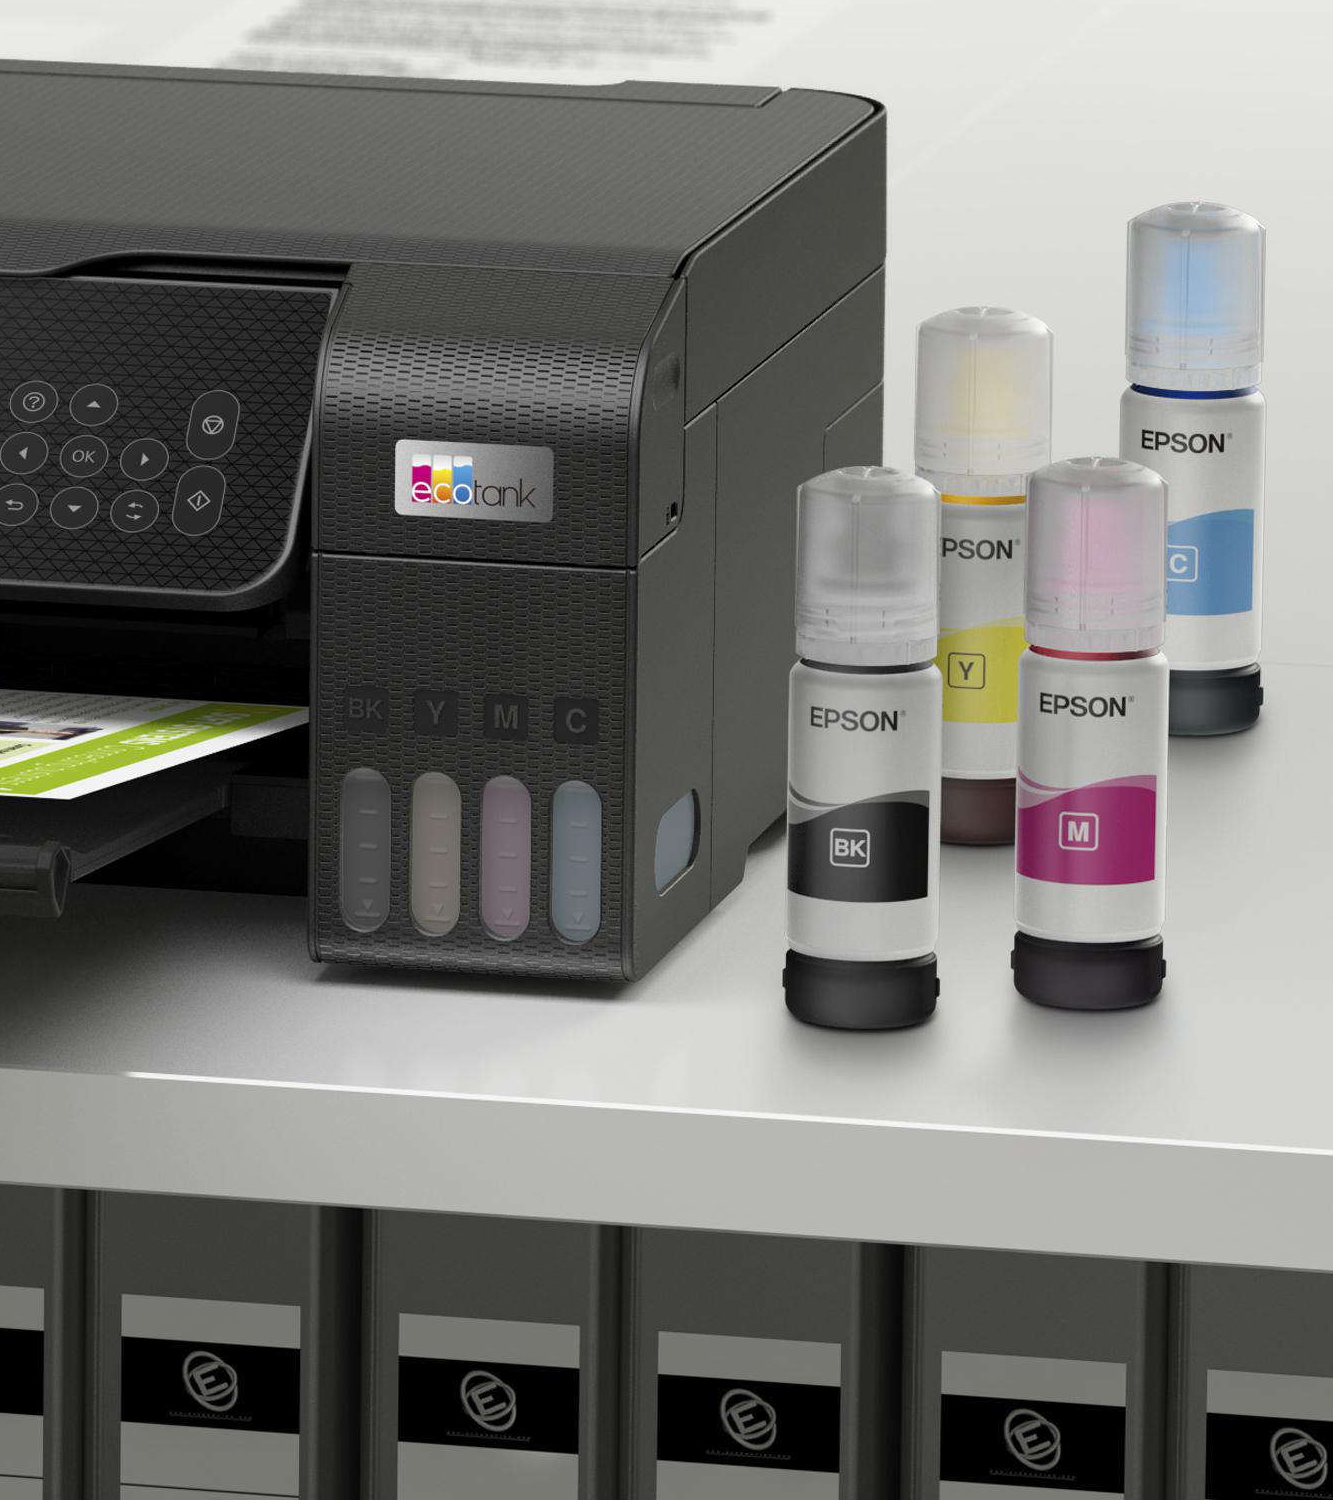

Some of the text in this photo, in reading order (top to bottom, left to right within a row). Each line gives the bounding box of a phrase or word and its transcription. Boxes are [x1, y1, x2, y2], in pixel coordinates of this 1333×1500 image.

[1140, 429, 1226, 454] EPSON
[72, 449, 96, 464] OK
[411, 478, 537, 509] ecotank
[1169, 554, 1188, 574] C
[959, 661, 974, 681] Y
[348, 696, 383, 721] BK
[425, 700, 446, 725] Y
[493, 704, 519, 730] M
[1039, 692, 1127, 718] EPSON
[565, 708, 587, 734] C
[808, 707, 899, 732] EPSON
[1067, 821, 1090, 842] M
[834, 837, 867, 859] BK
